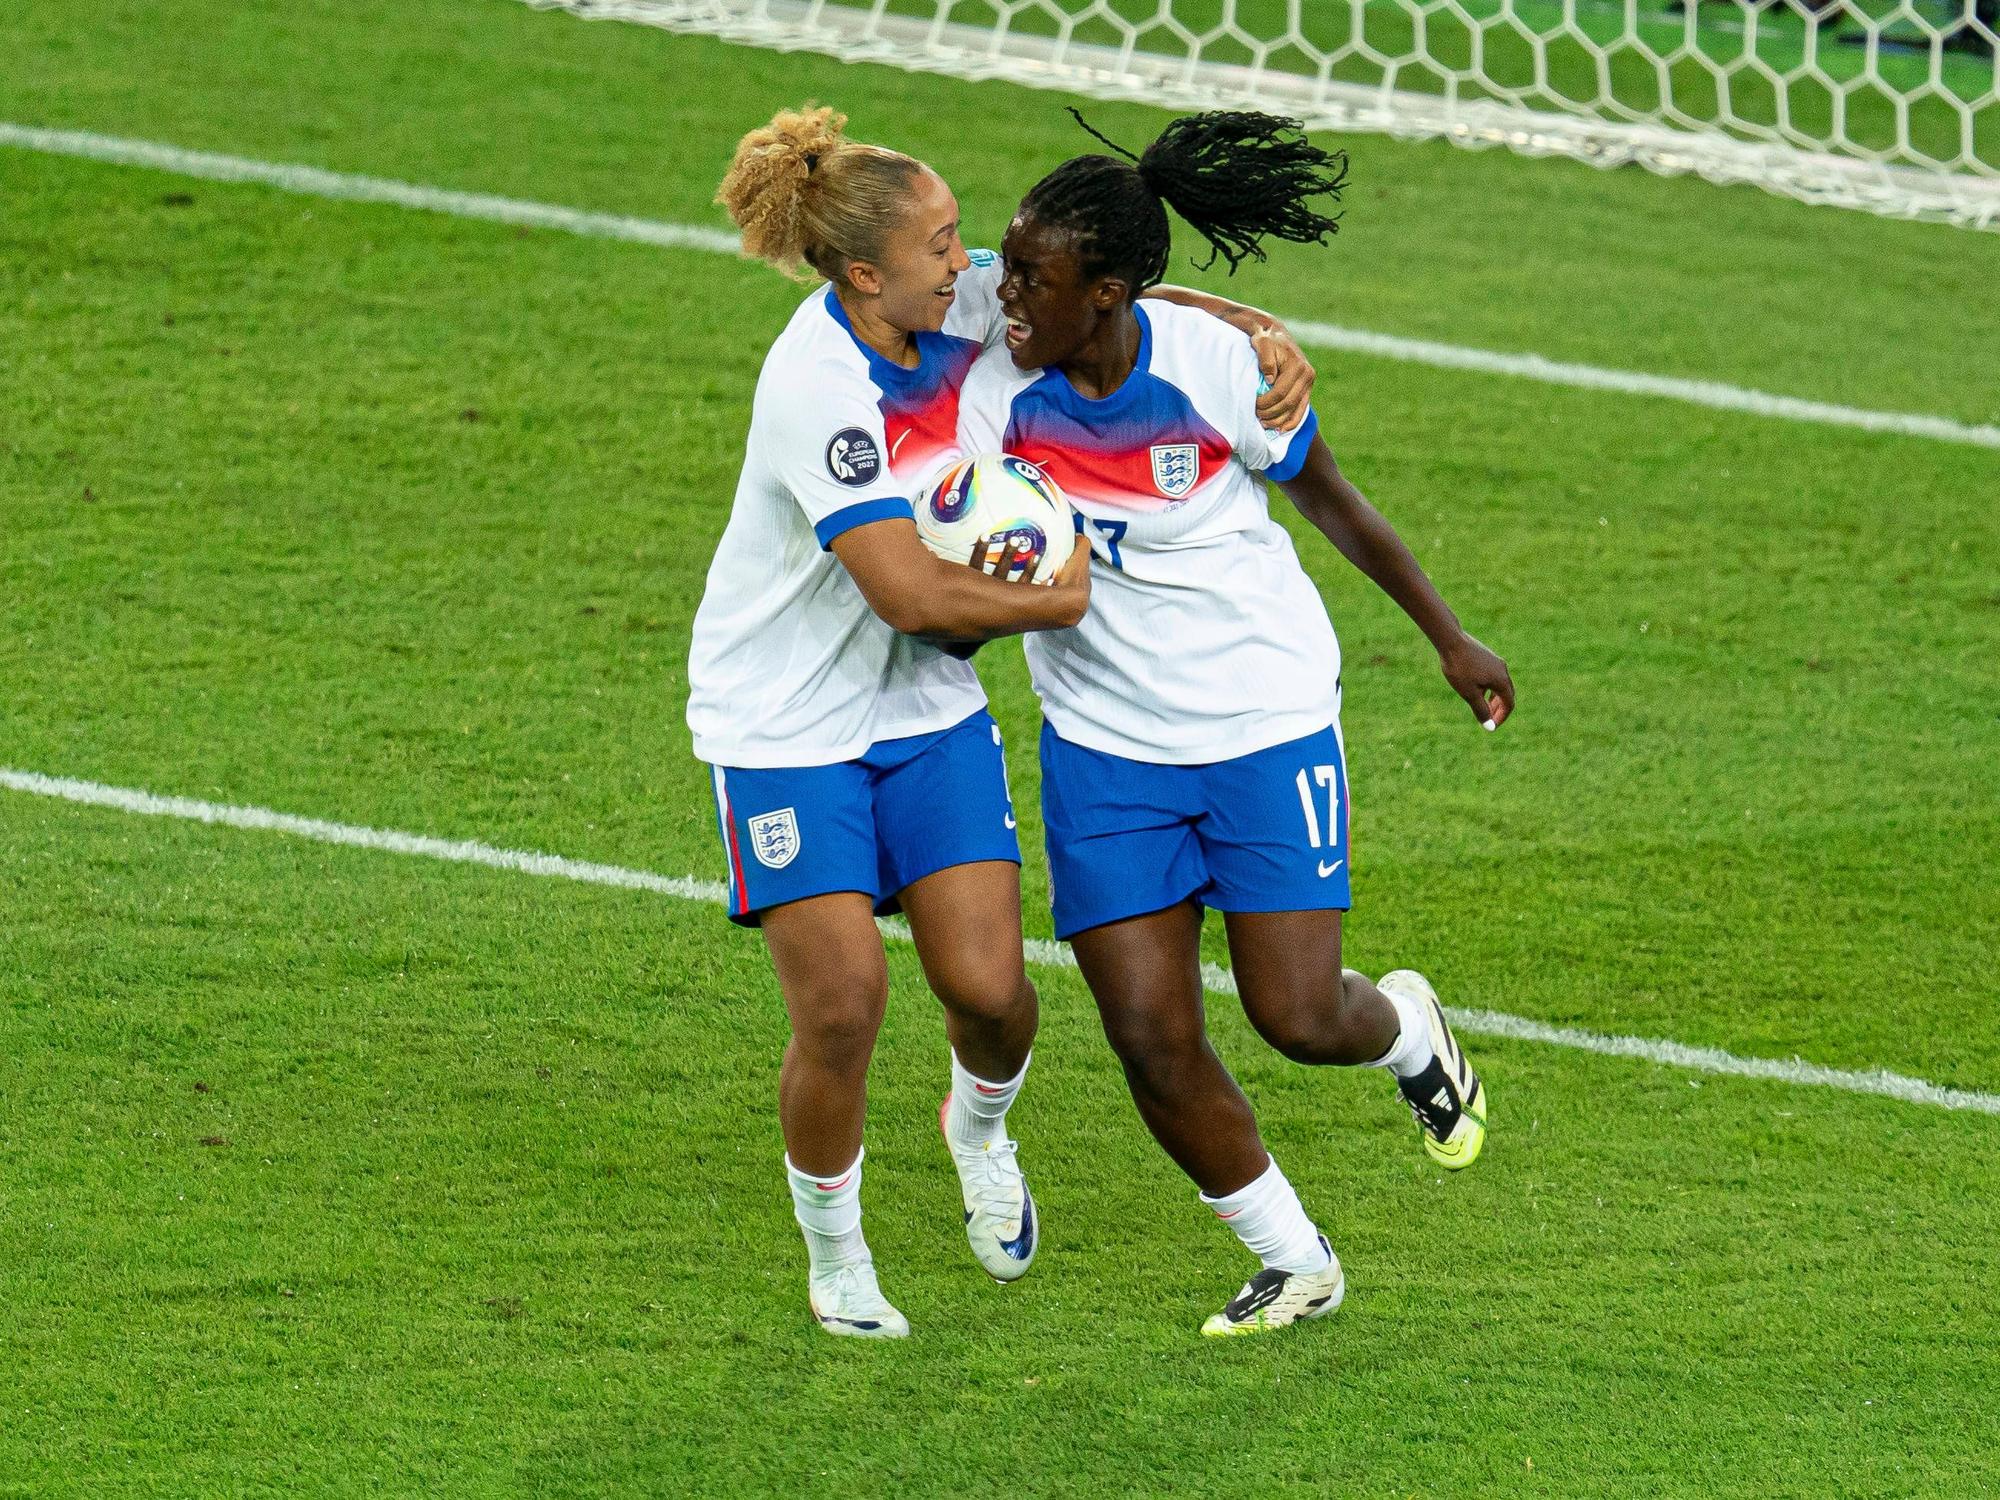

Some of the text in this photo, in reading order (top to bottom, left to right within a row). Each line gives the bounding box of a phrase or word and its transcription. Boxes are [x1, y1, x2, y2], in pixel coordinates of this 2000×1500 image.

[849, 449, 875, 457] EUROPEAN
[849, 454, 877, 463] CHAMPIONS
[857, 461, 875, 469] 2022
[1295, 764, 1339, 848] 17
